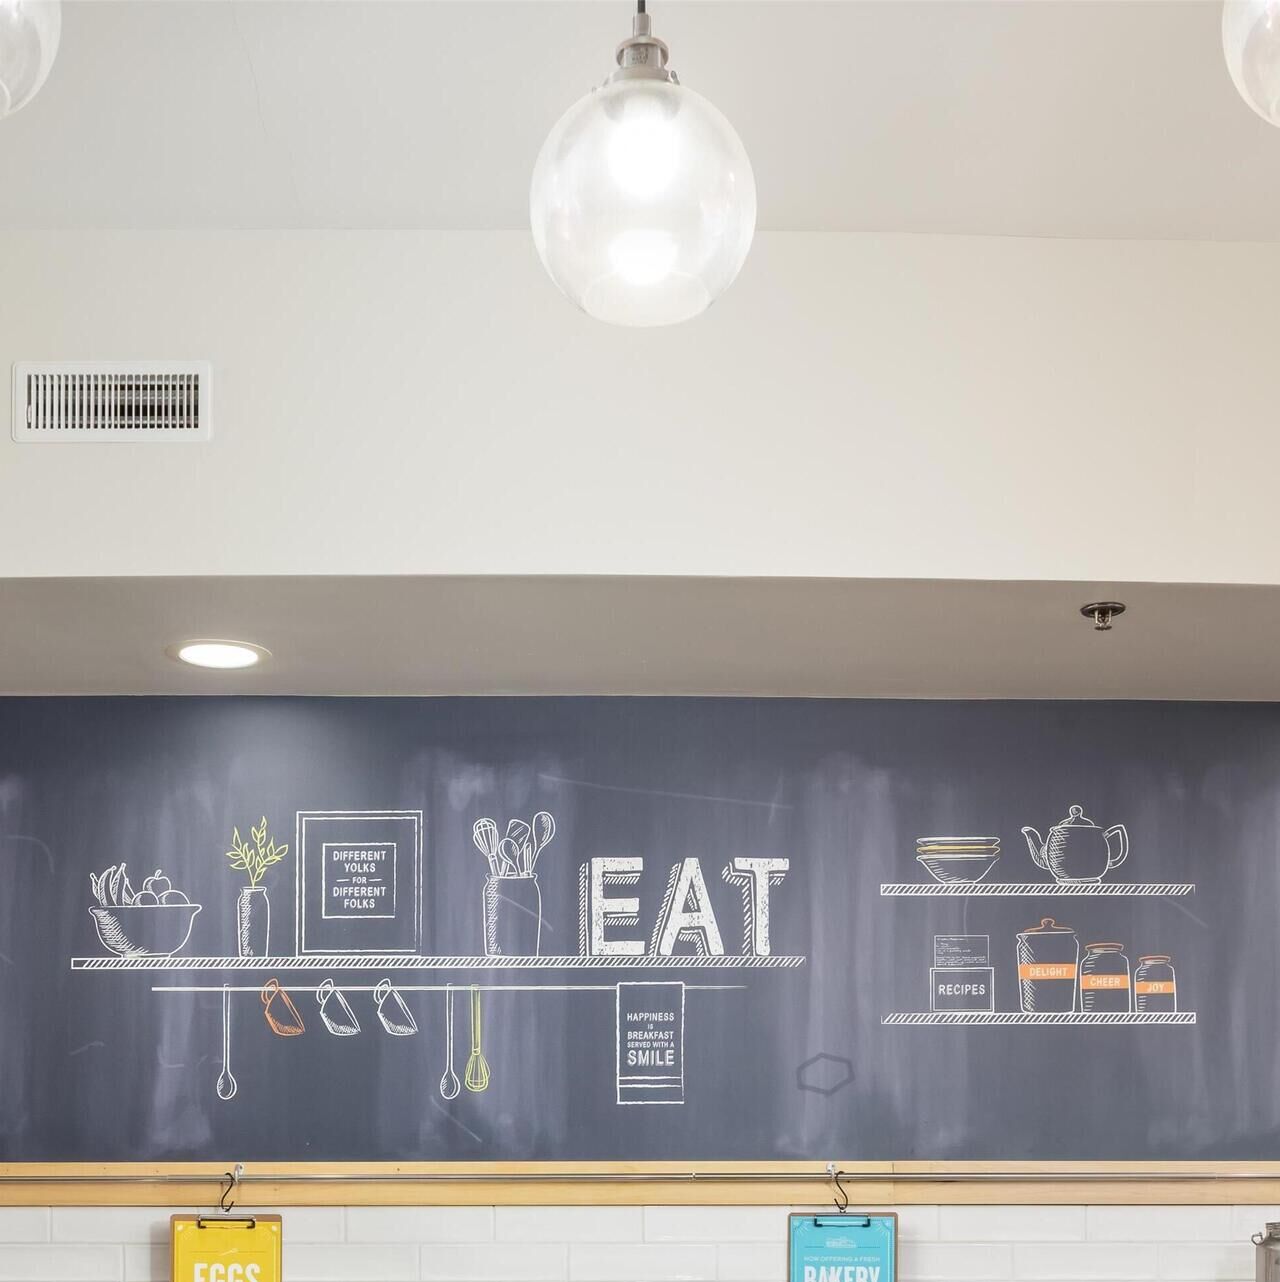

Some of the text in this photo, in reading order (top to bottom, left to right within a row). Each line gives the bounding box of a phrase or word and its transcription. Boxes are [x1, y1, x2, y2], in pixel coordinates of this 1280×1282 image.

[333, 850, 387, 861] DIFFERENT
[344, 862, 376, 873] YOLKS
[352, 876, 367, 884] FOR
[333, 886, 387, 897] DIFFERENT
[343, 899, 376, 909] FOLKS
[580, 857, 789, 956] EAT
[1029, 966, 1068, 978] DELIGHT
[1089, 976, 1121, 988] CHEER
[1146, 982, 1165, 993] JOY
[938, 983, 986, 996] RECIPES
[627, 1012, 675, 1021] HAPPINESS
[627, 1031, 674, 1040] BREAKFAST
[627, 1049, 675, 1066] SMILE
